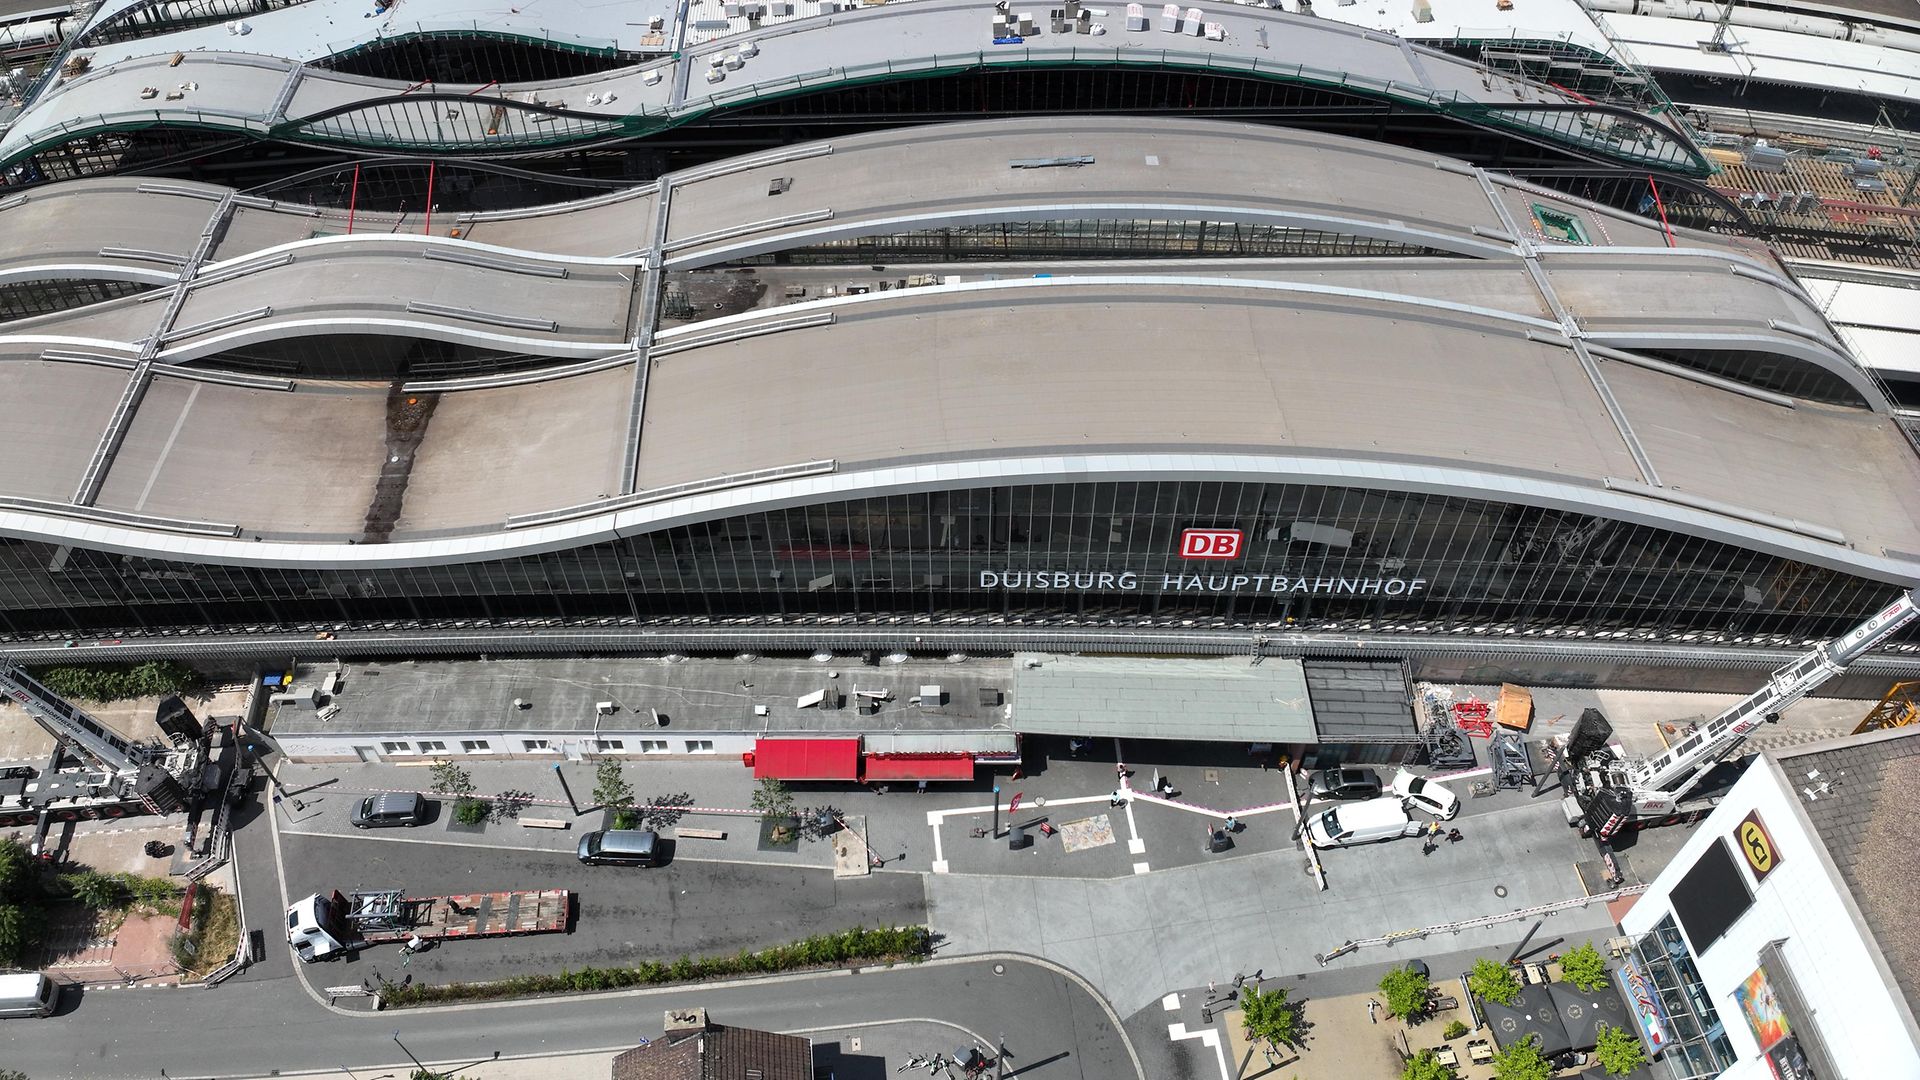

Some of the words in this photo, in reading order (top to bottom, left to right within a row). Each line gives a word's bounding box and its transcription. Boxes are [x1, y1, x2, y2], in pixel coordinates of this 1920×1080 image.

[1186, 534, 1236, 556] DB
[980, 571, 1137, 590] DUISBURG
[1163, 573, 1427, 596] HAUPTBAHNHOF
[1745, 827, 1768, 866] UCI
